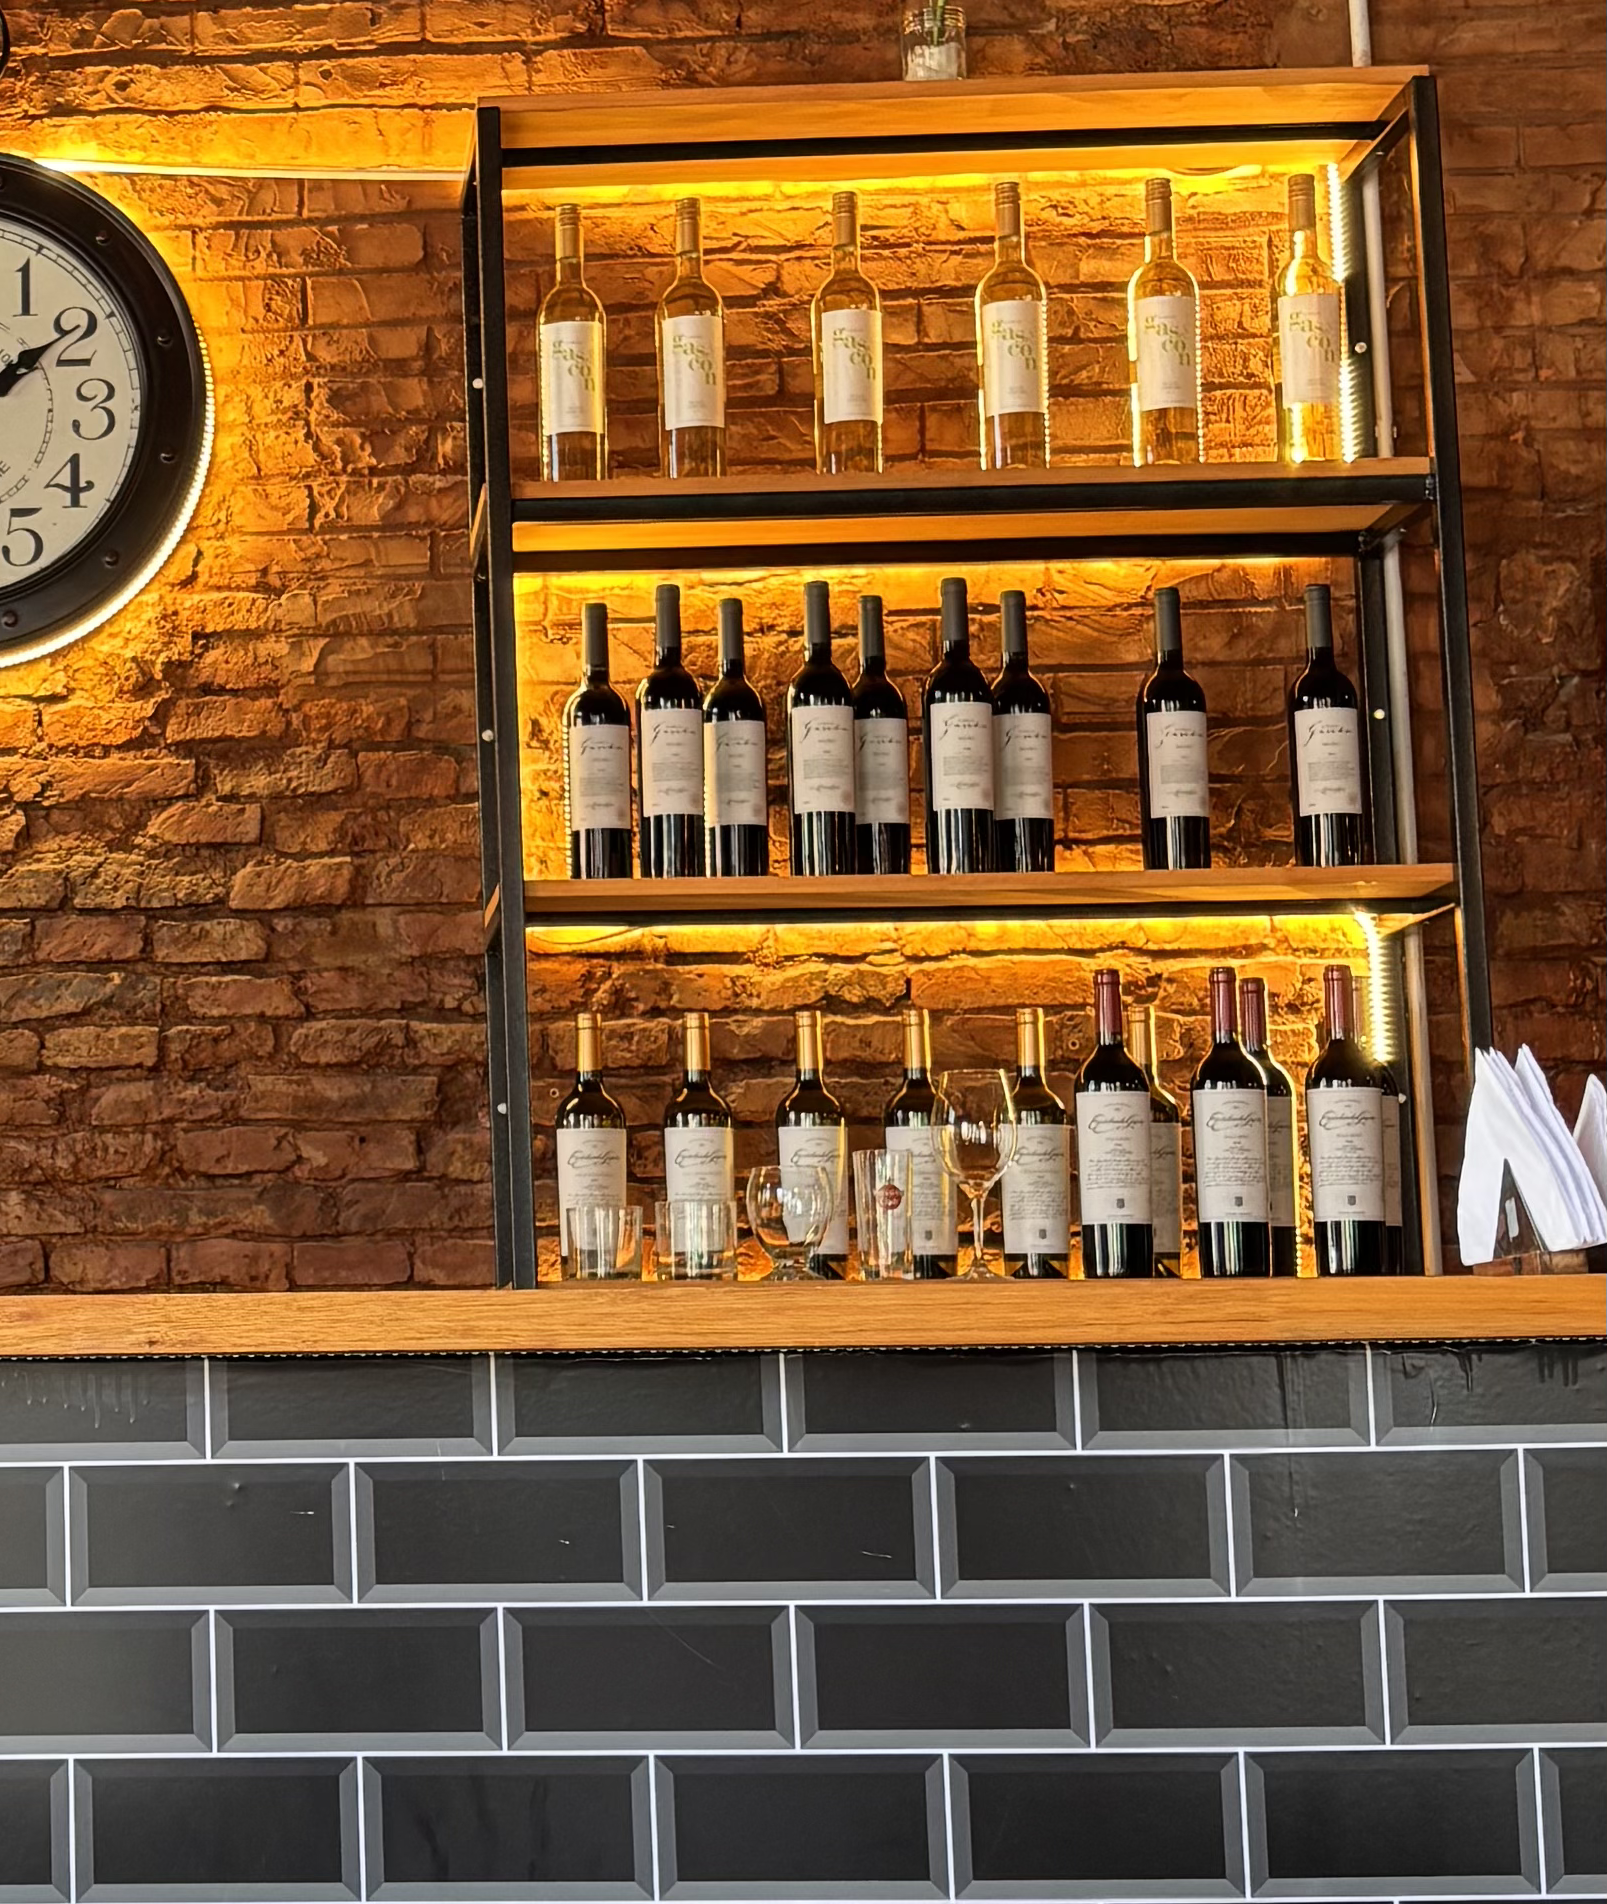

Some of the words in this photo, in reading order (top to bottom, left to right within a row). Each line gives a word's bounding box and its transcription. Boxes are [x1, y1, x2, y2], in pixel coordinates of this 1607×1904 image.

[13, 258, 39, 317] 1
[52, 306, 98, 367] 2
[71, 378, 116, 441] 3
[43, 453, 95, 509] 4
[1, 507, 44, 567] 5
